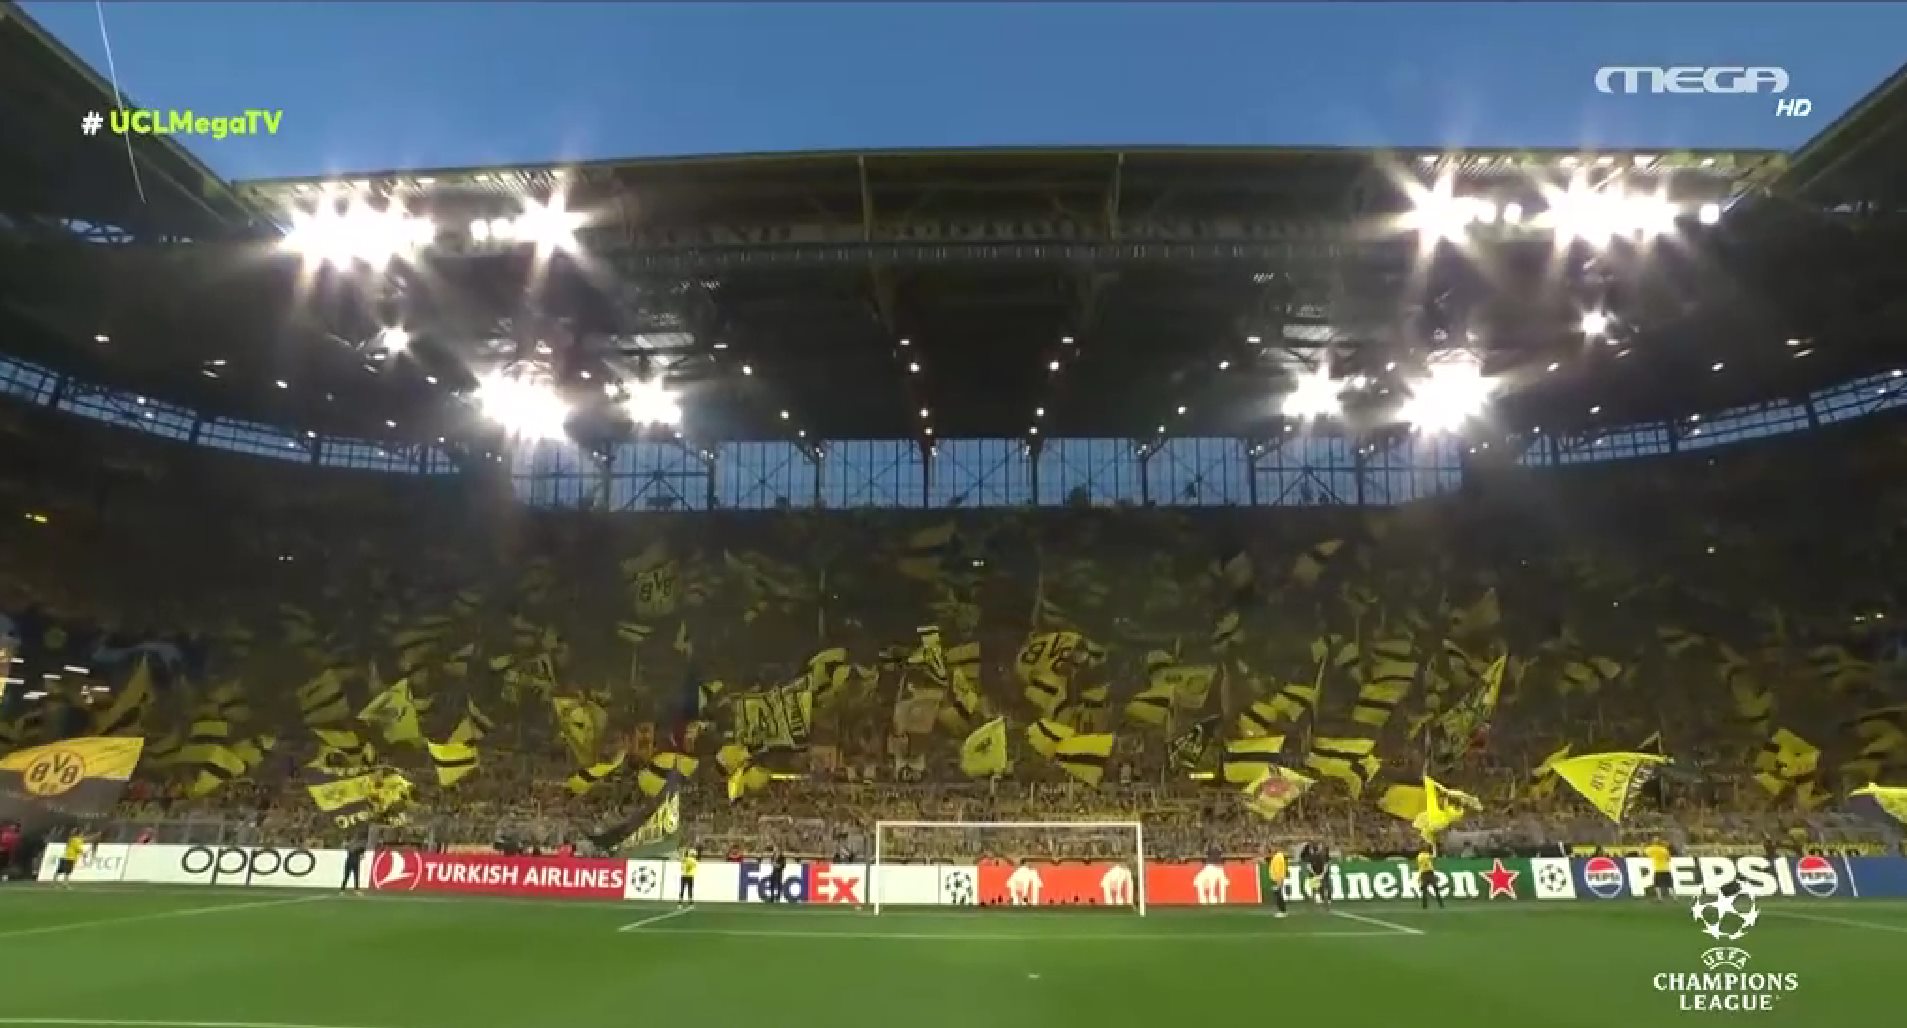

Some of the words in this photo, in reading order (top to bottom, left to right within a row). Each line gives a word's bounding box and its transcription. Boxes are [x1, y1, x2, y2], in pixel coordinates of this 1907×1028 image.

[182, 846, 317, 886] oppo
[425, 861, 519, 886] TURKISH
[523, 865, 624, 891] AIRLINES
[740, 859, 861, 904] FedEx
[1626, 857, 1797, 897] PEPSI
